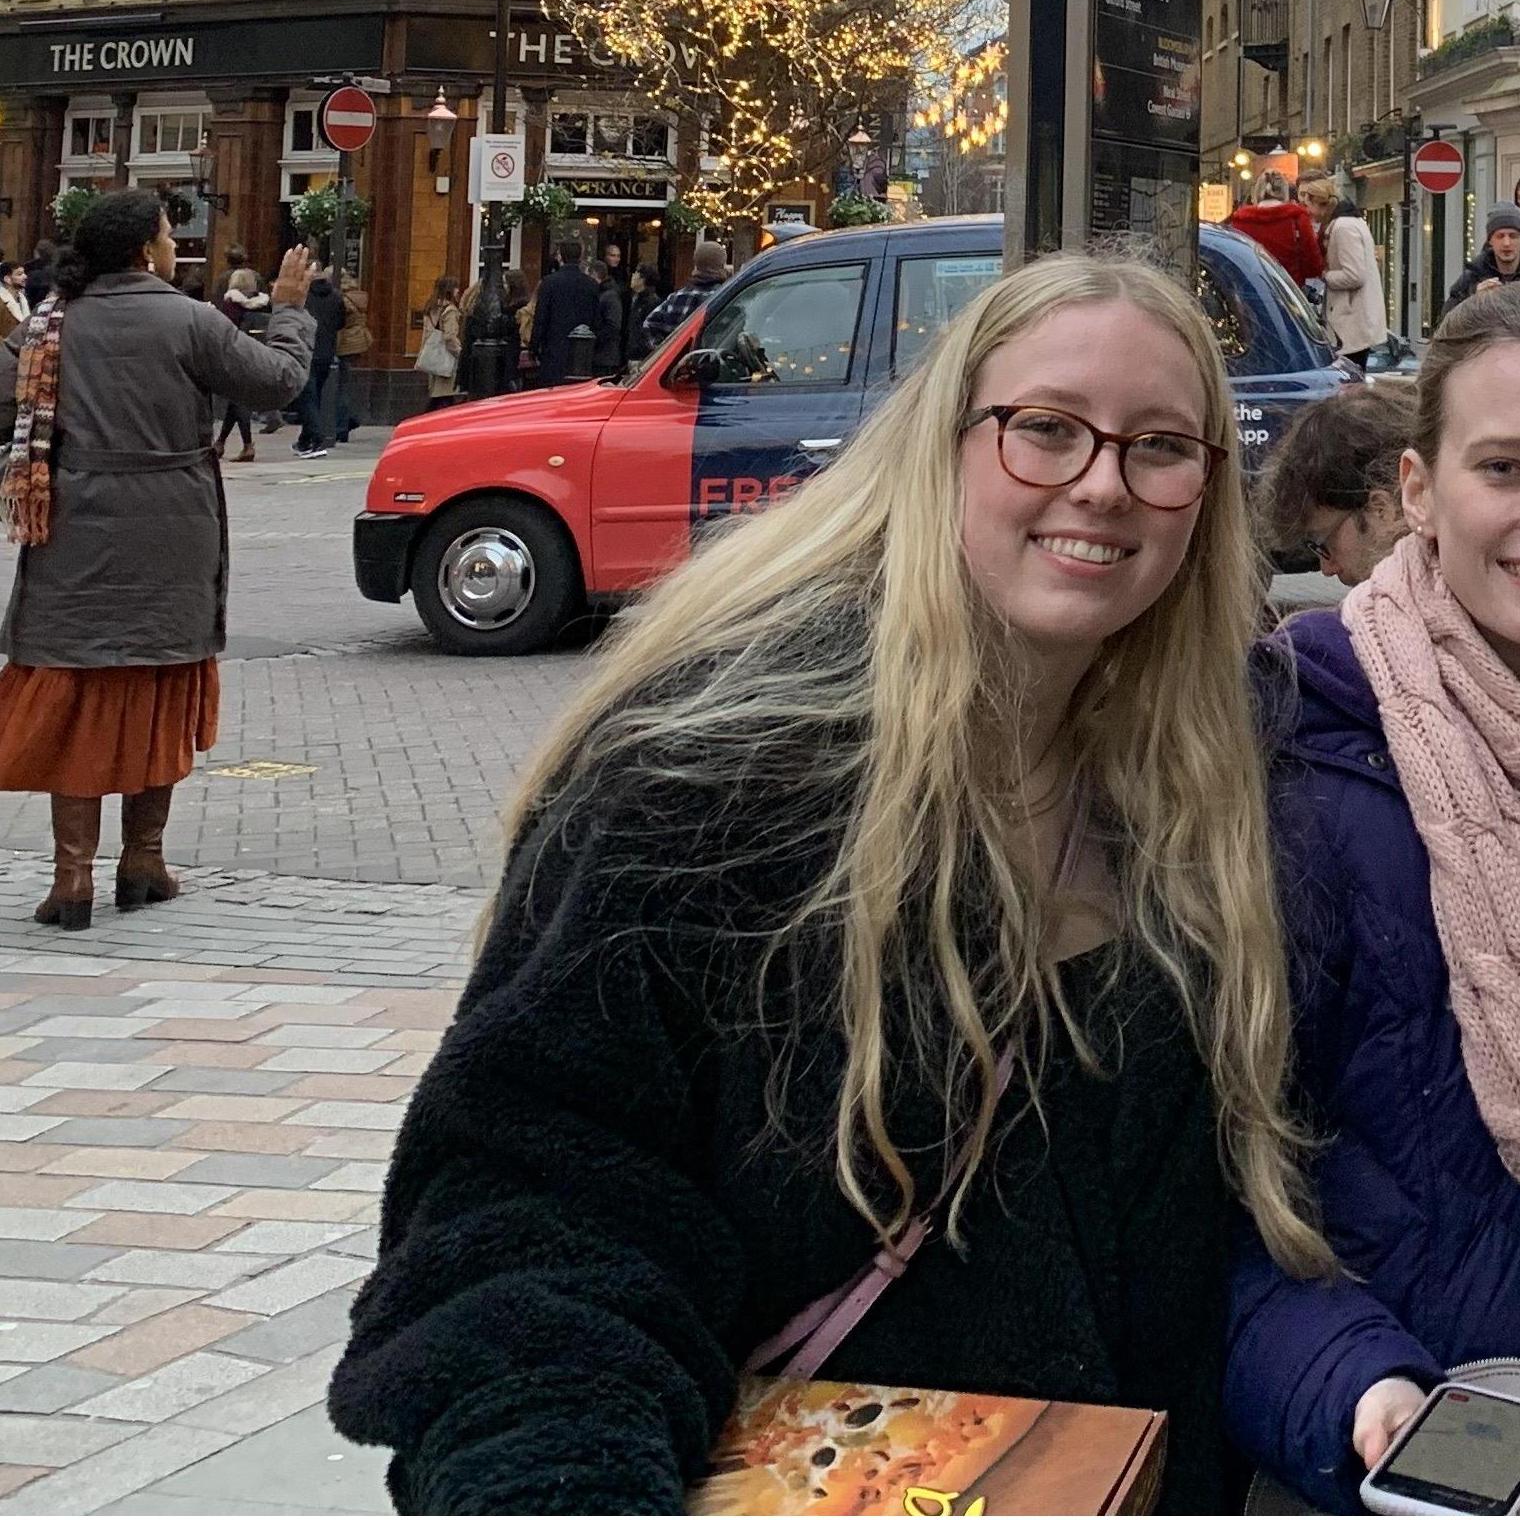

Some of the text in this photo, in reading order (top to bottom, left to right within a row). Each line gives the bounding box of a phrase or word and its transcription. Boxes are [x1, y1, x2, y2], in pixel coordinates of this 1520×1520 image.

[50, 37, 194, 72] THE CROWN
[1233, 403, 1263, 421] the
